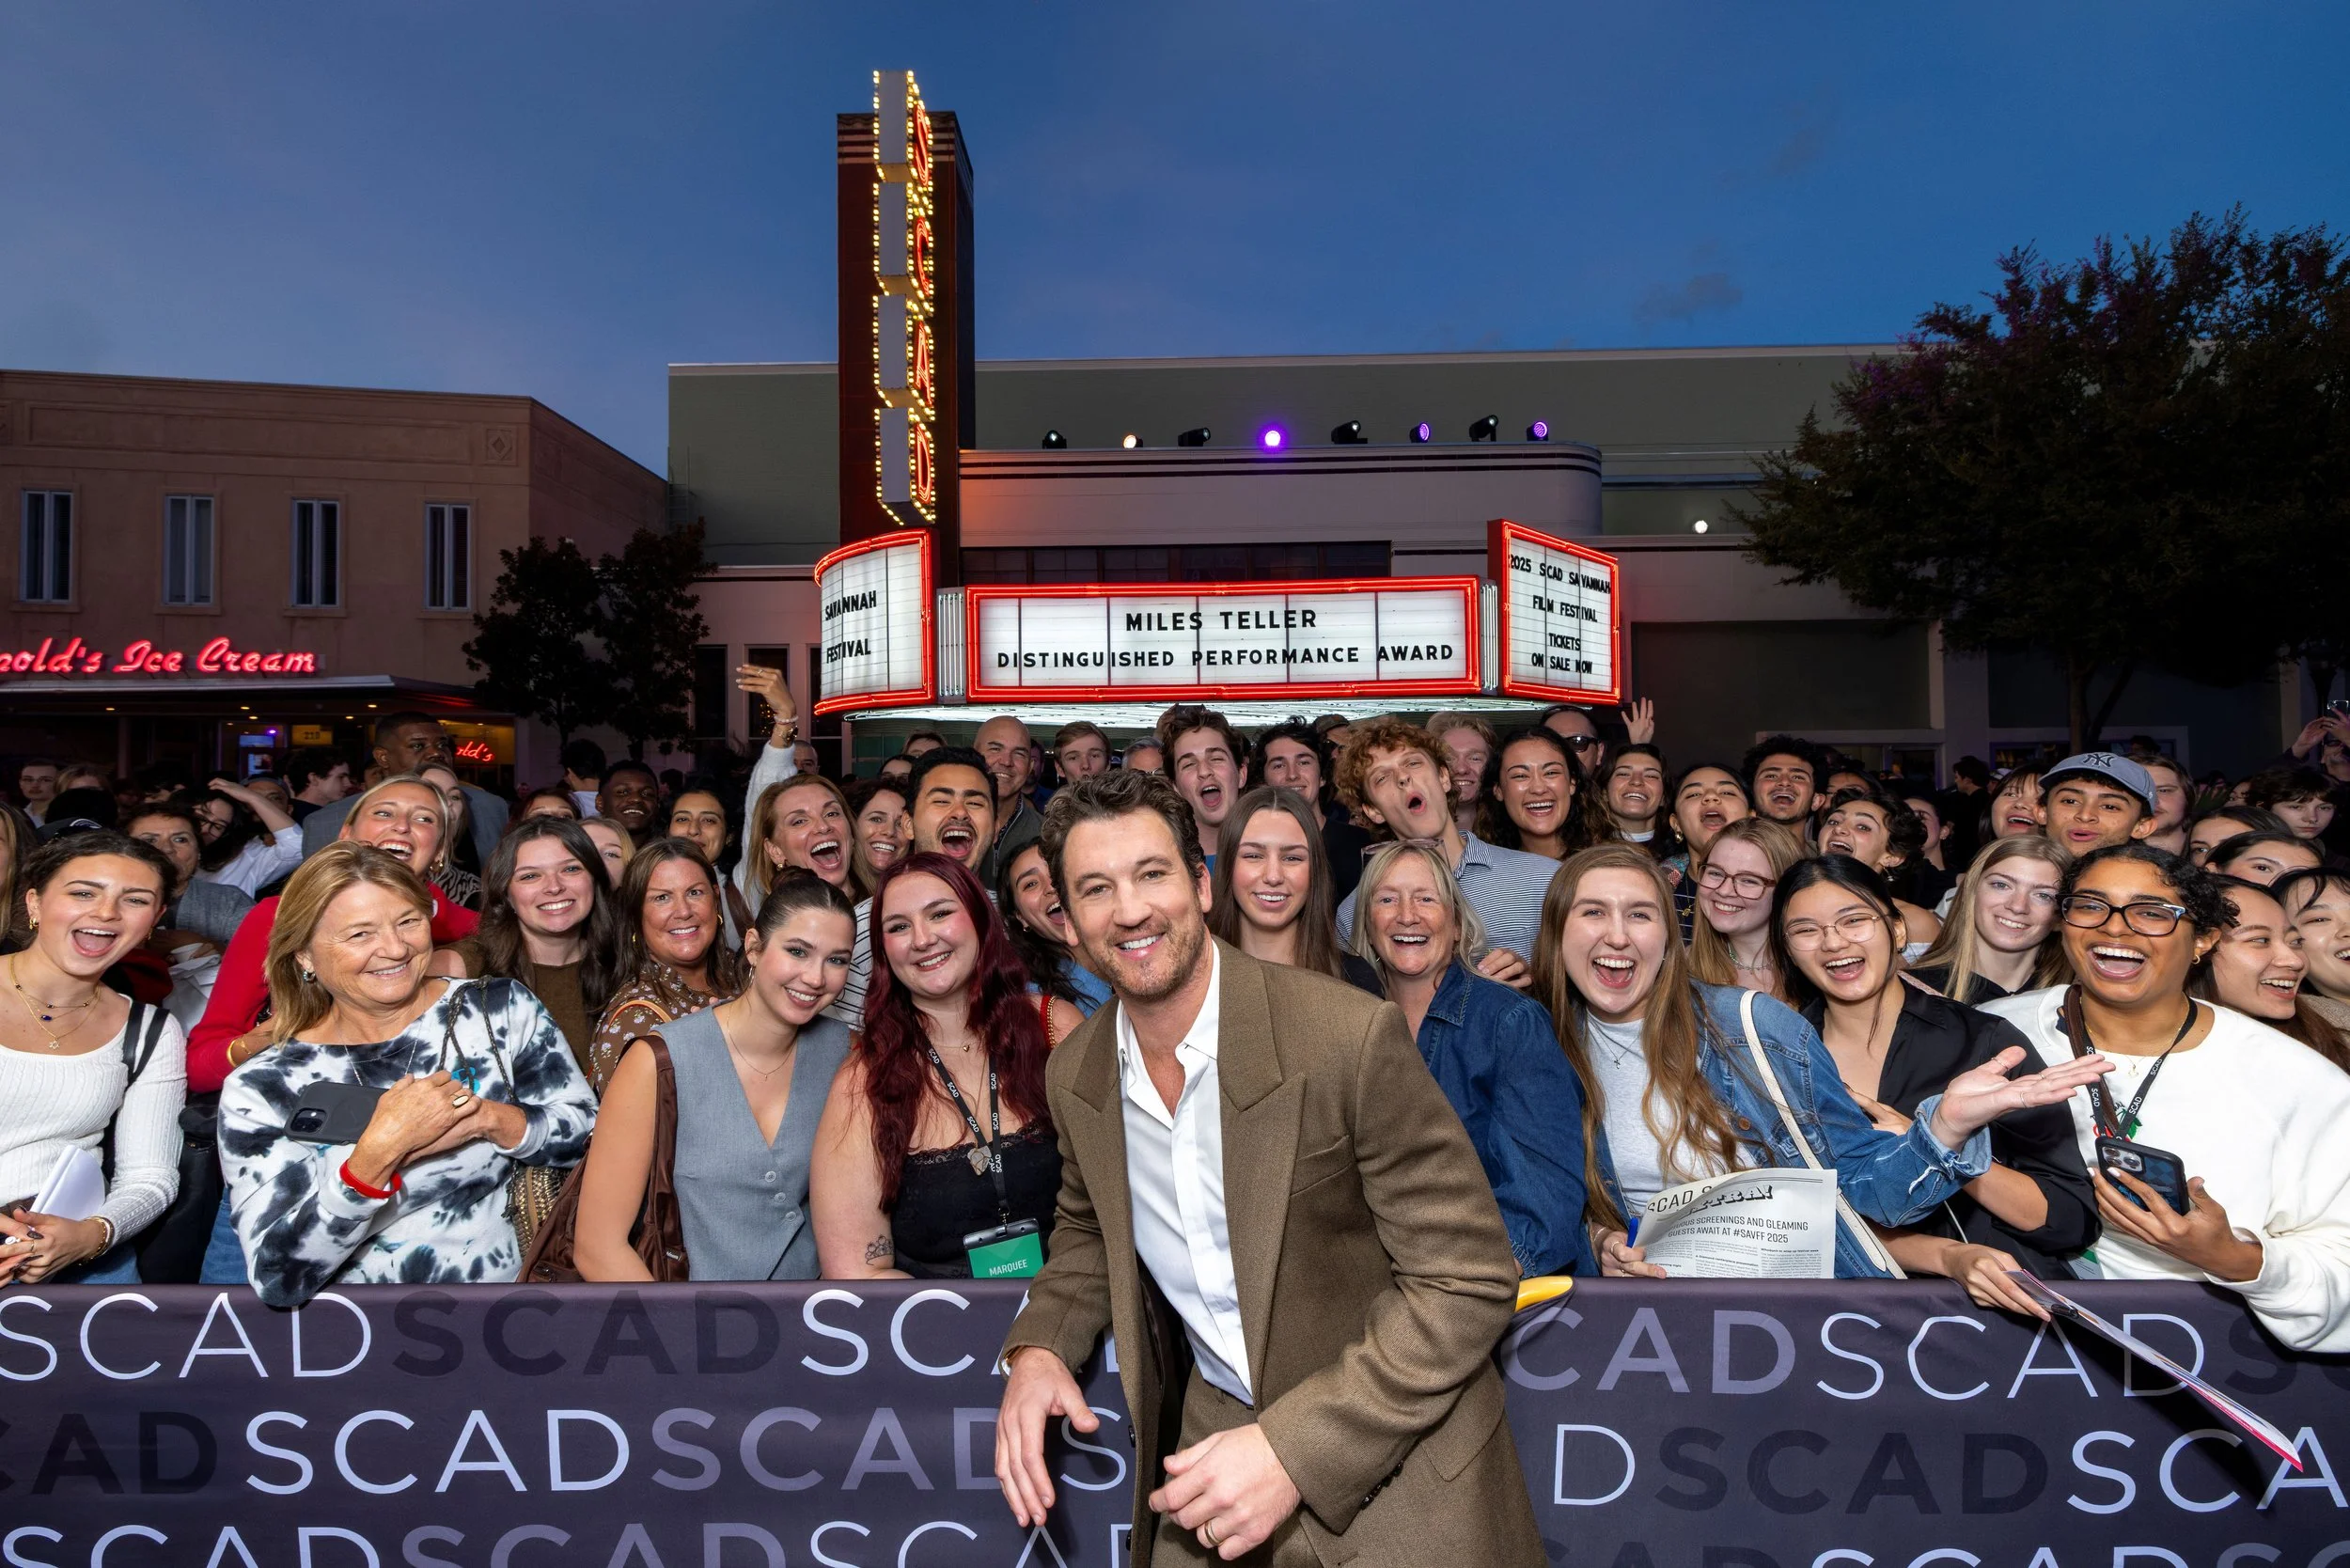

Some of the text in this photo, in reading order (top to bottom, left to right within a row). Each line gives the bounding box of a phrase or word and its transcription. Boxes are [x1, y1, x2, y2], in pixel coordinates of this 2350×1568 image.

[913, 104, 932, 504] SCAD
[1509, 554, 1611, 594] 2025 SCAD SAVANNAH
[825, 590, 877, 621] SAVANNAH
[1532, 595, 1598, 622] FILM FESTIVAL
[1126, 609, 1317, 631] MILES TELLER
[826, 638, 871, 664] FESTIVAL
[1548, 633, 1581, 651] TICKETS
[112, 639, 183, 673] Ice
[196, 636, 316, 673] Cream
[997, 644, 1453, 667] DISTINGUISHED PERFORMANCE AWARD
[1531, 652, 1593, 675] ON SALE NOW
[927, 1047, 941, 1065] SCAD
[2150, 1058, 2163, 1076] SCAD
[947, 1081, 960, 1099] SCAD
[2091, 1088, 2101, 1107] SCAD
[2128, 1096, 2143, 1115] SCAD
[966, 1116, 980, 1134] SCAD
[1696, 1215, 1746, 1225] SCREENINGS
[1747, 1216, 1764, 1228] AND
[1766, 1218, 1809, 1231] GLEAMING
[1668, 1226, 1789, 1244] GUESTS AWAIT AT #SAVFF 2025
[989, 1259, 1028, 1277] MARQUEE
[0, 1292, 372, 1382] SCAD
[392, 1289, 781, 1377] SCAD
[1506, 1305, 1796, 1396] CAD
[1816, 1311, 2205, 1401] SCAD
[0, 1411, 218, 1495] AD
[246, 1408, 630, 1496] SCAD
[1654, 1425, 2050, 1515] SCAD
[810, 1520, 1133, 1568] SCA
